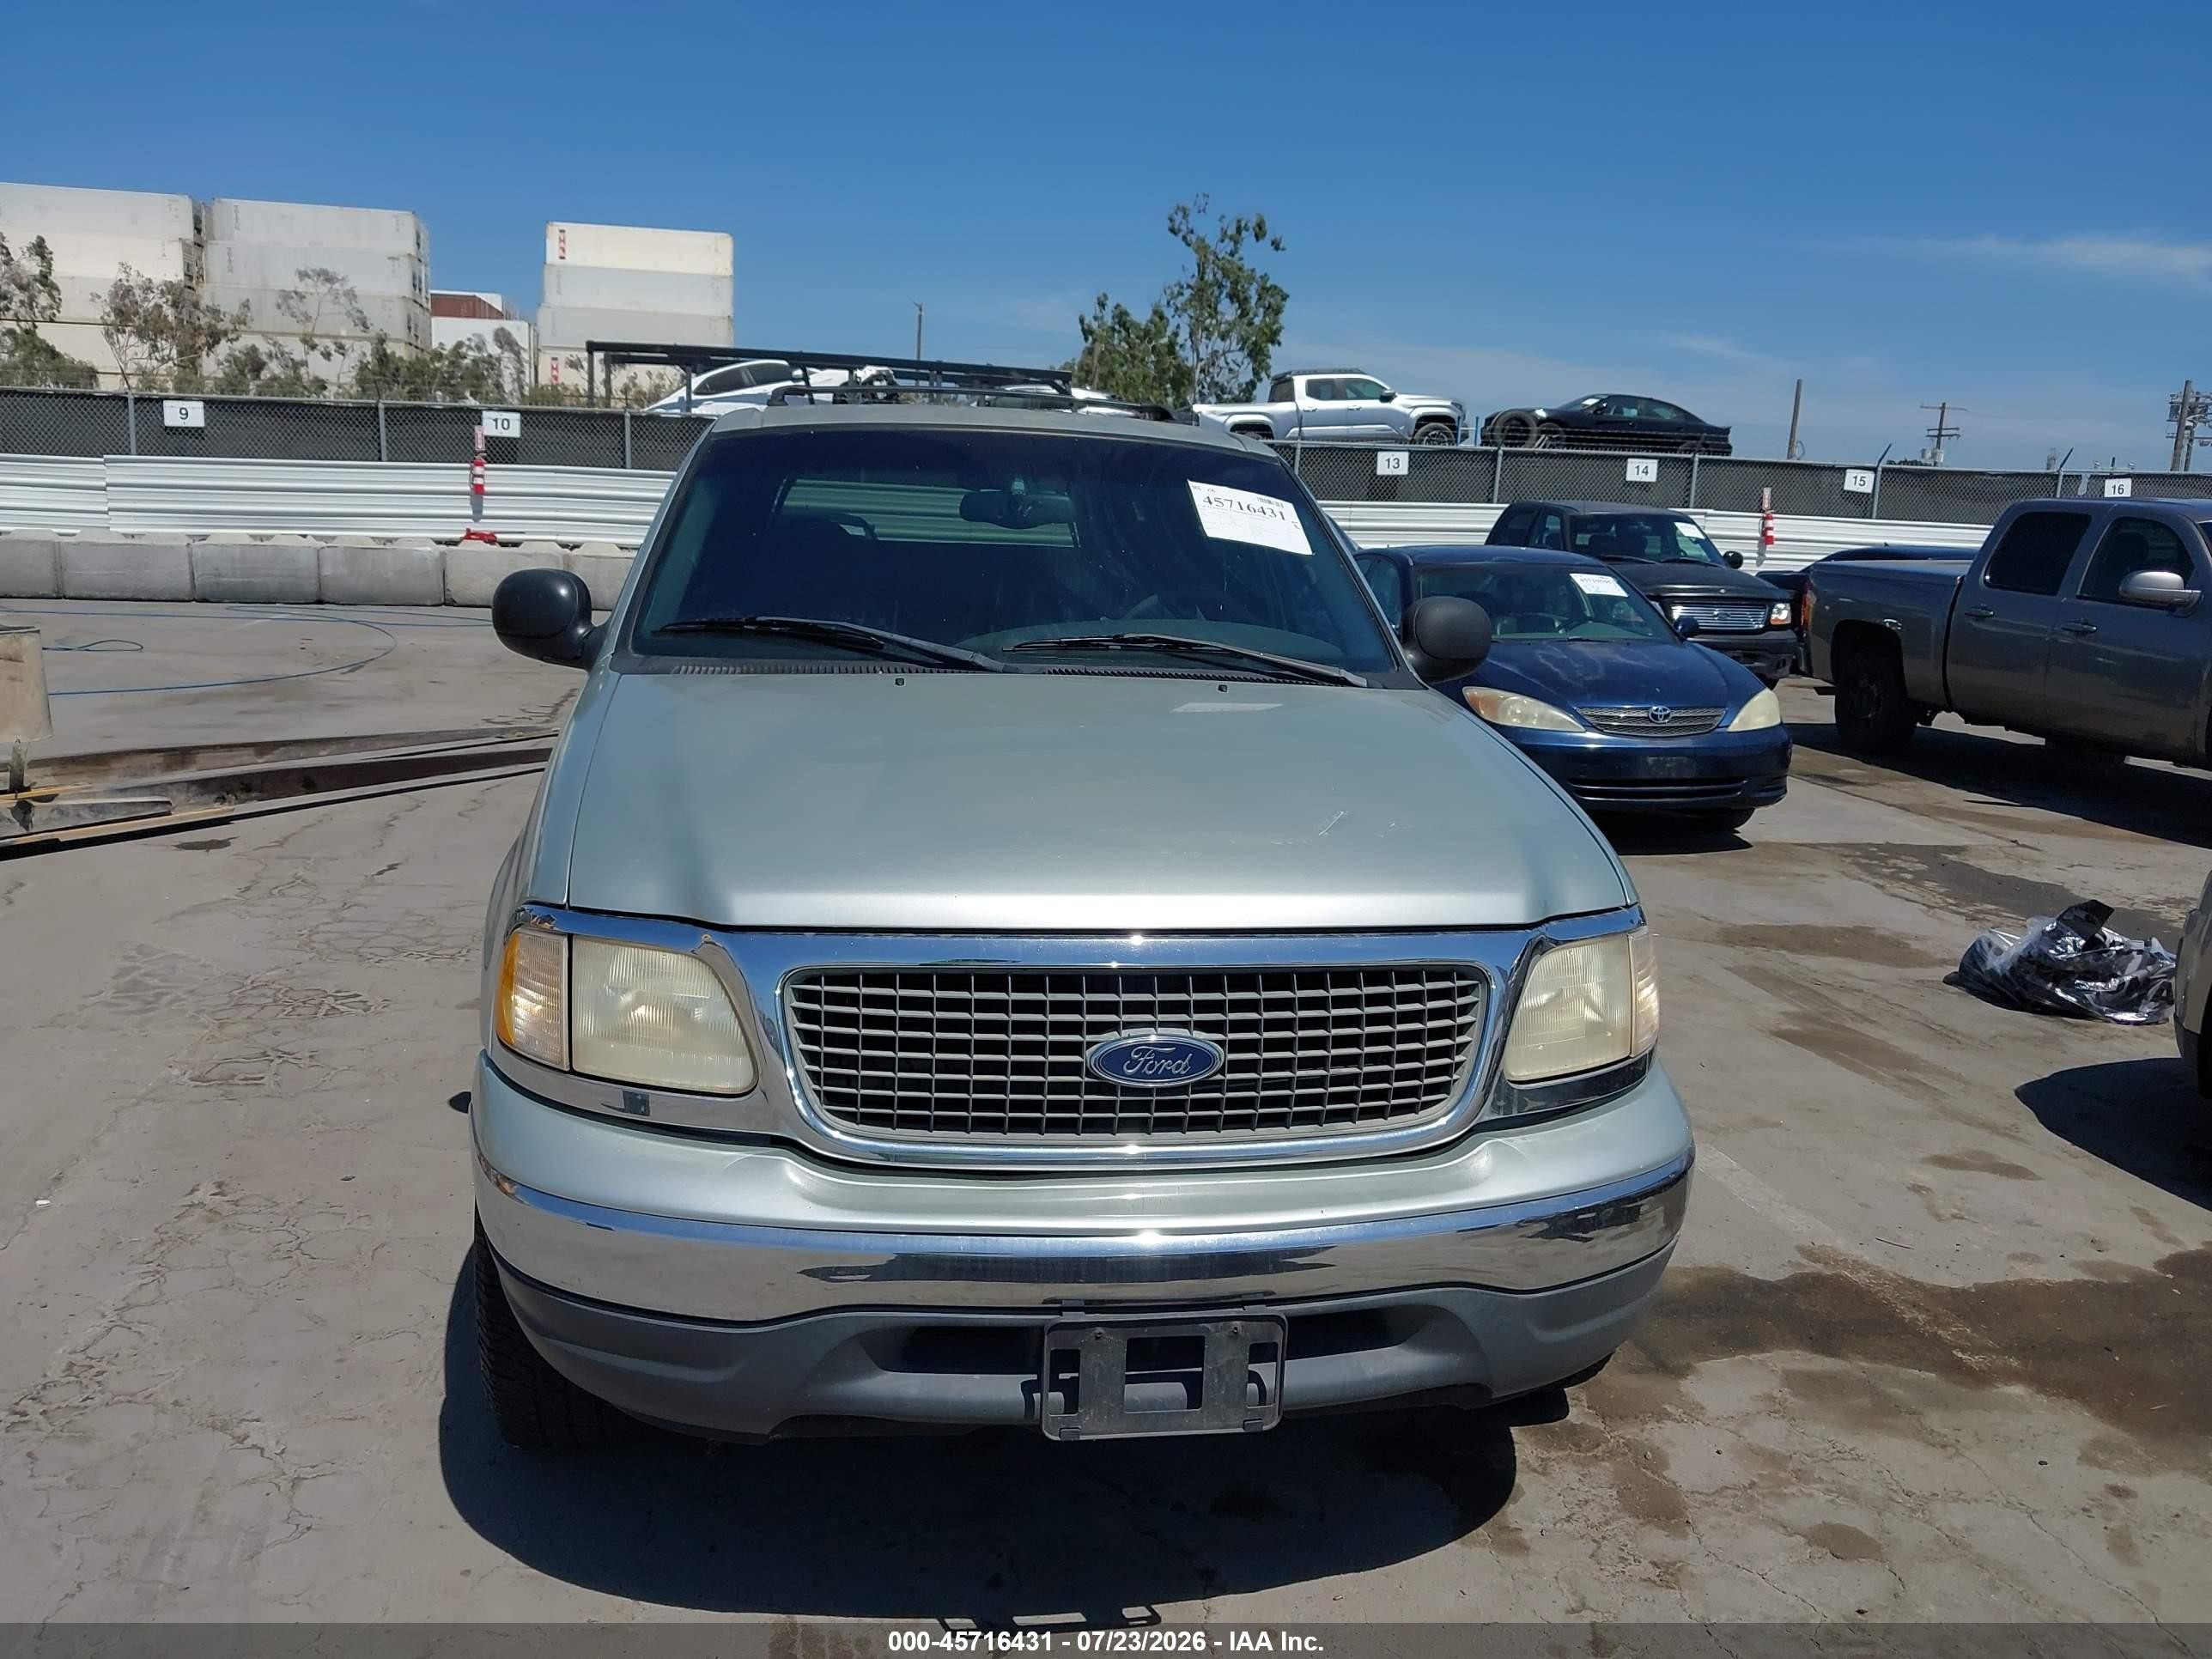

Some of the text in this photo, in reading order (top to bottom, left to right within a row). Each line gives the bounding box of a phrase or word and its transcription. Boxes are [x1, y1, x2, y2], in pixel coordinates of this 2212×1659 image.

[179, 407, 189, 420] 9
[493, 417, 510, 431] 10
[1384, 457, 1401, 470] 13
[1634, 465, 1650, 477] 14
[1852, 475, 1867, 487] 15
[2112, 483, 2125, 495] 16
[1203, 495, 1285, 520] 45716431
[1123, 1045, 1193, 1075] Ford
